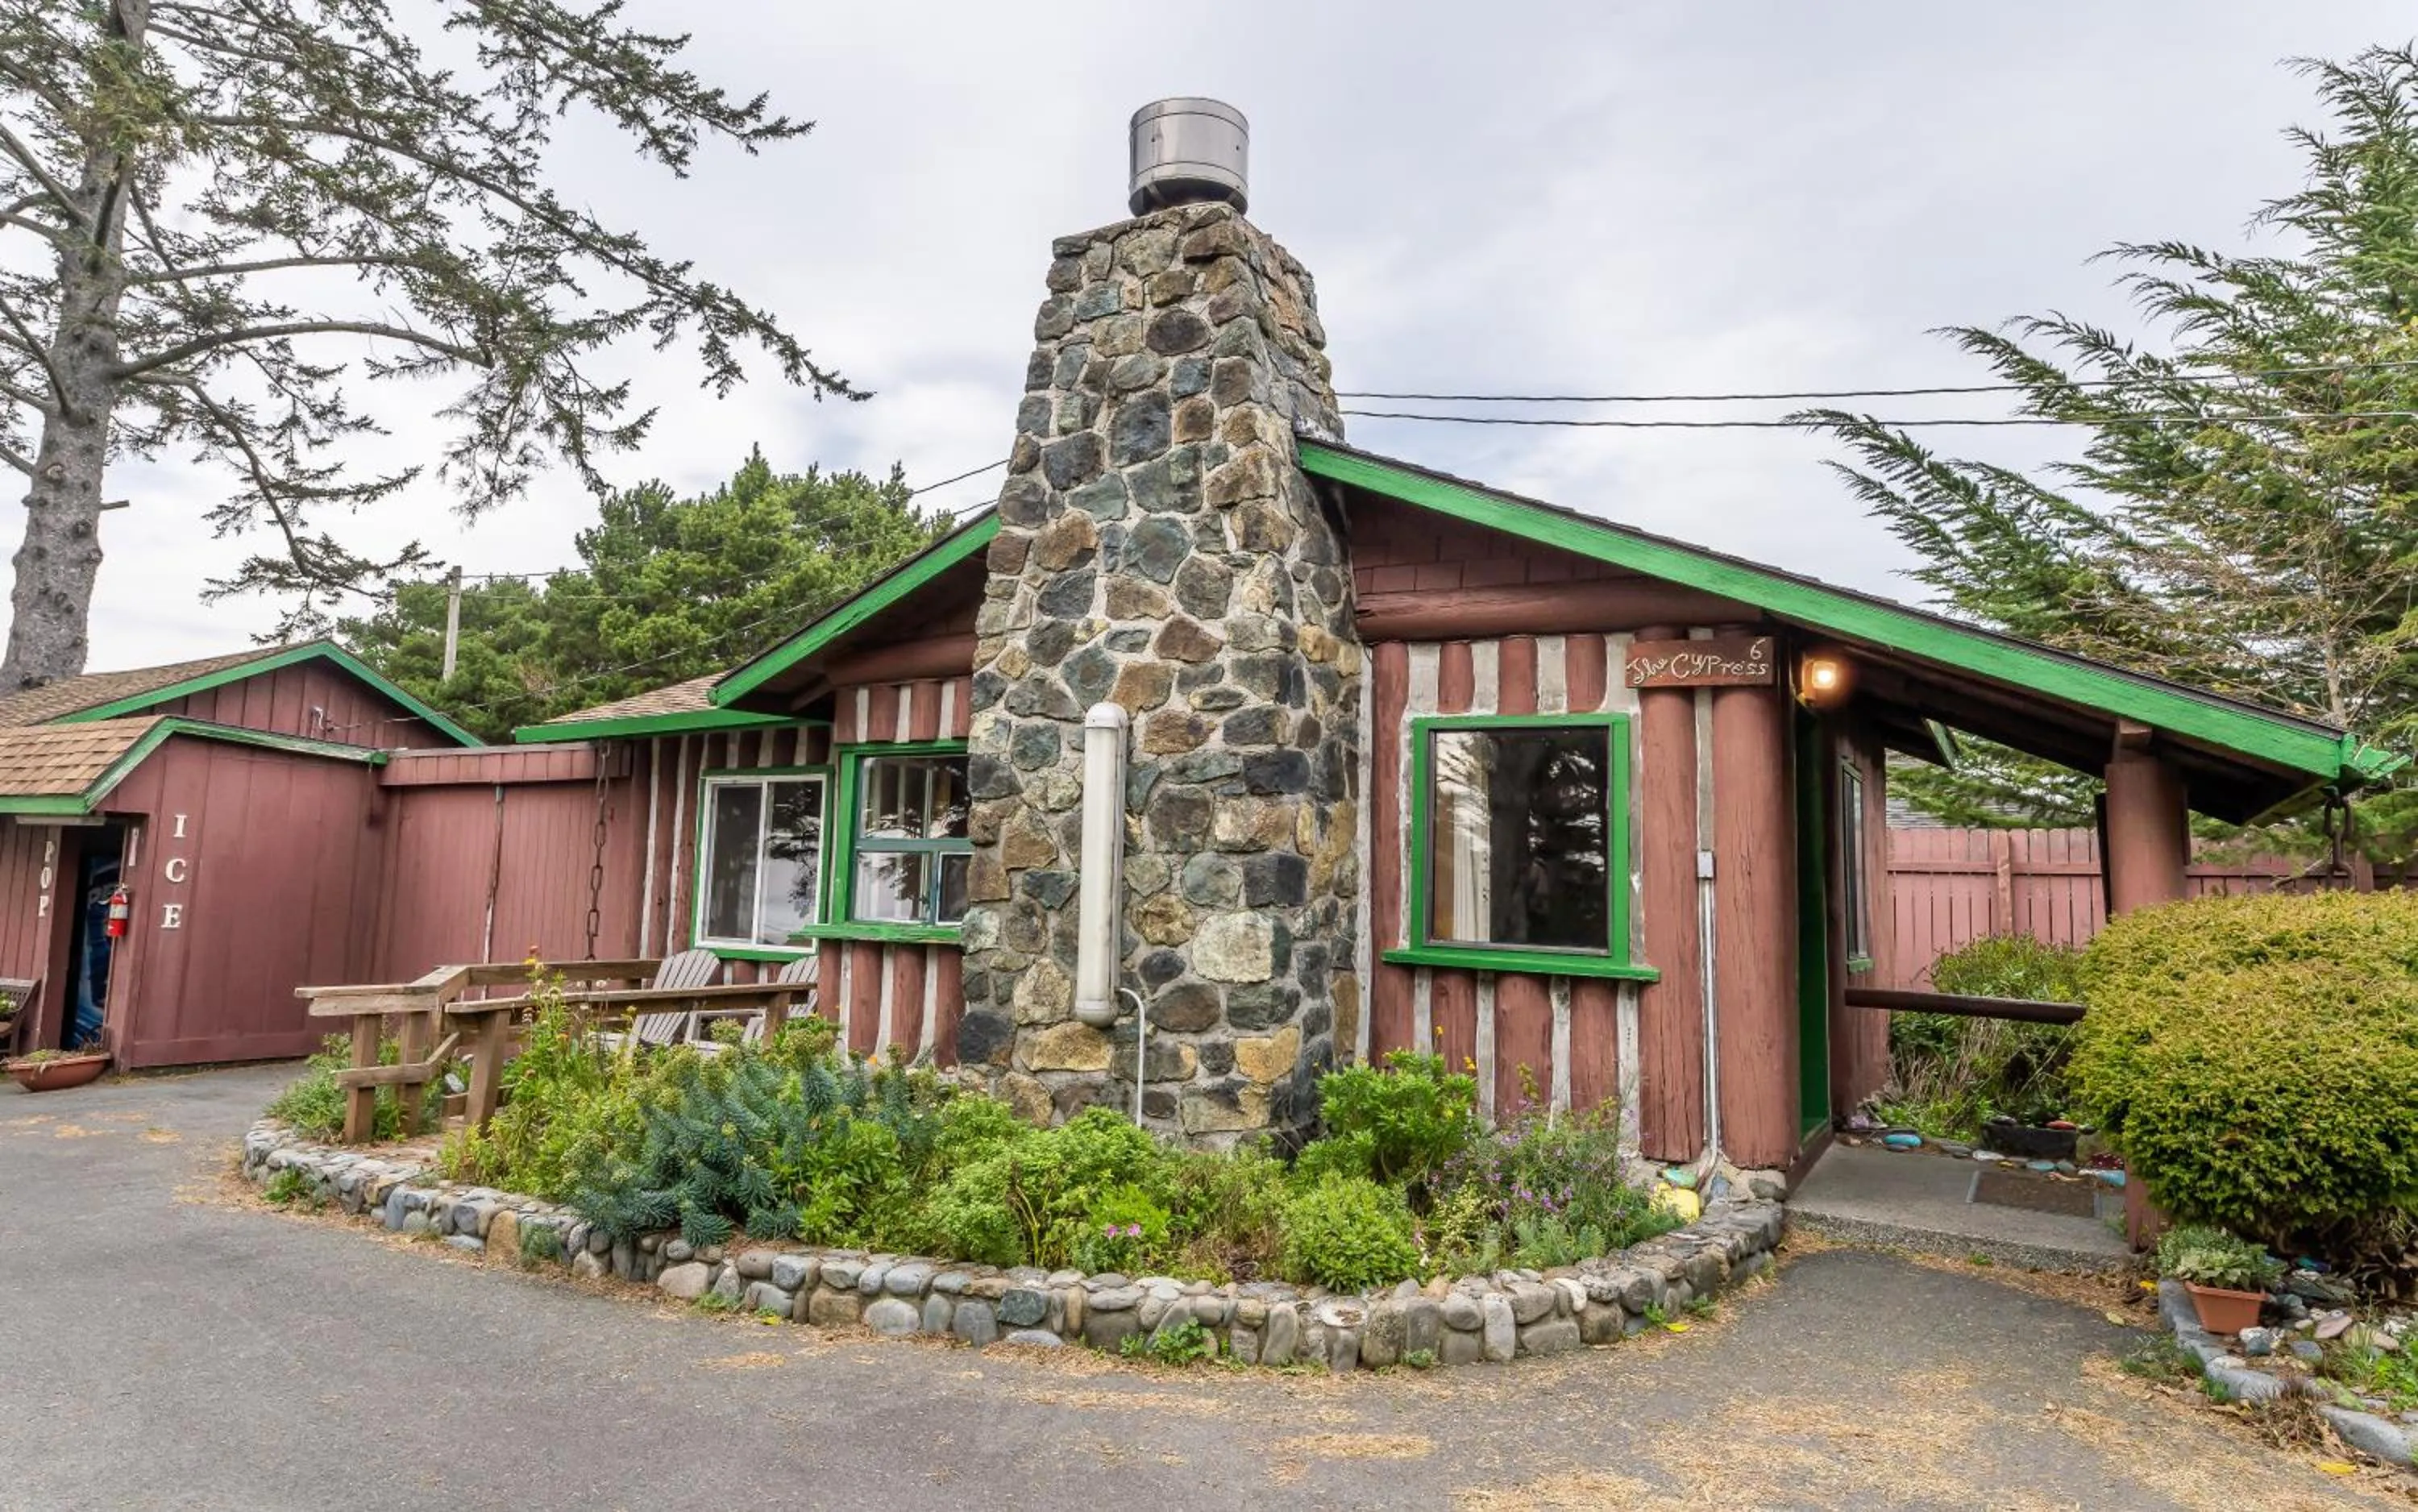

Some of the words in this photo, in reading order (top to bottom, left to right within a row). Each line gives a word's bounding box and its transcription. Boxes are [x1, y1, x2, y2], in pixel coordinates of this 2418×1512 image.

[1627, 658, 1668, 684] The
[1750, 638, 1766, 660] 6
[38, 841, 55, 916] POP
[160, 814, 188, 928] ICE
